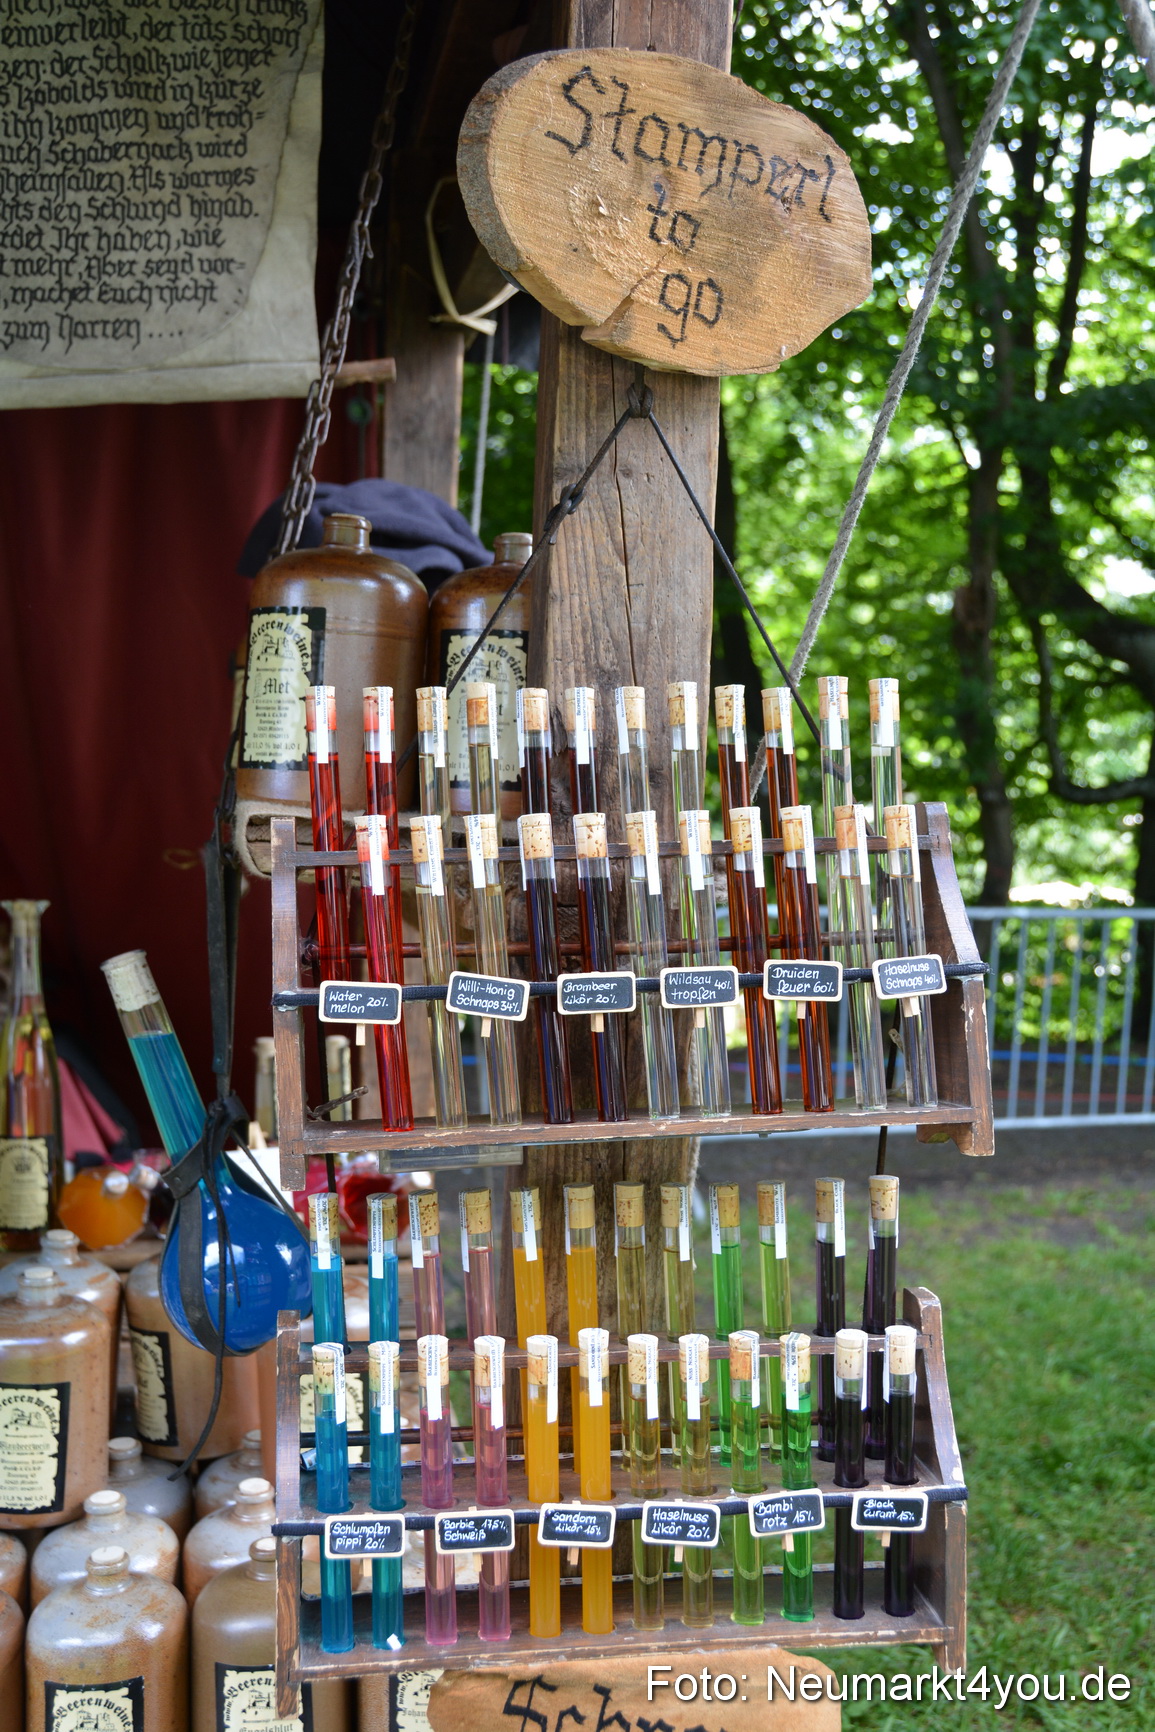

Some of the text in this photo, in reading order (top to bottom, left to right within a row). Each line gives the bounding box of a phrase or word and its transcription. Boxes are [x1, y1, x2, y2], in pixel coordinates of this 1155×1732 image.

[1, 9, 139, 48] einverleibt,
[139, 12, 176, 42] der
[230, 19, 299, 57] schon
[50, 50, 89, 78] der
[170, 46, 213, 73] wie
[211, 43, 278, 79] jener
[111, 72, 166, 103] wird
[45, 107, 150, 144] kommen
[154, 103, 200, 135] und
[45, 135, 192, 171] Schabernack
[196, 133, 247, 157] wird
[544, 66, 836, 223] Stamperl
[168, 166, 259, 193] warmes
[39, 197, 81, 230] den
[84, 191, 181, 228] Schlund
[647, 174, 701, 255] to
[181, 222, 226, 248] wie
[657, 270, 724, 348] go
[0, 320, 50, 352] zum
[55, 311, 141, 355] Narren
[771, 967, 819, 979] Druiden
[884, 963, 930, 976] Haselnuss
[563, 982, 618, 992] Brombeer
[669, 974, 711, 985] Wildsau
[885, 976, 923, 990] Schnaps
[458, 979, 515, 999] Willi-Honig
[671, 987, 717, 1003] tropfen
[777, 981, 812, 995] feuer
[329, 991, 362, 1002] Water
[456, 993, 500, 1012] Schnaps
[564, 994, 593, 1005] Likör
[330, 1003, 365, 1014] melon
[755, 1498, 793, 1516] Bambi
[863, 1499, 895, 1509] Black
[652, 1508, 709, 1523] Haselnuss
[762, 1516, 788, 1528] rotz
[332, 1522, 391, 1537] Schlumpfen
[443, 1519, 475, 1530] Barbie
[555, 1519, 583, 1532] Likör
[651, 1522, 682, 1535] Likör
[335, 1535, 362, 1549] pippi
[444, 1530, 486, 1541] Schweiß
